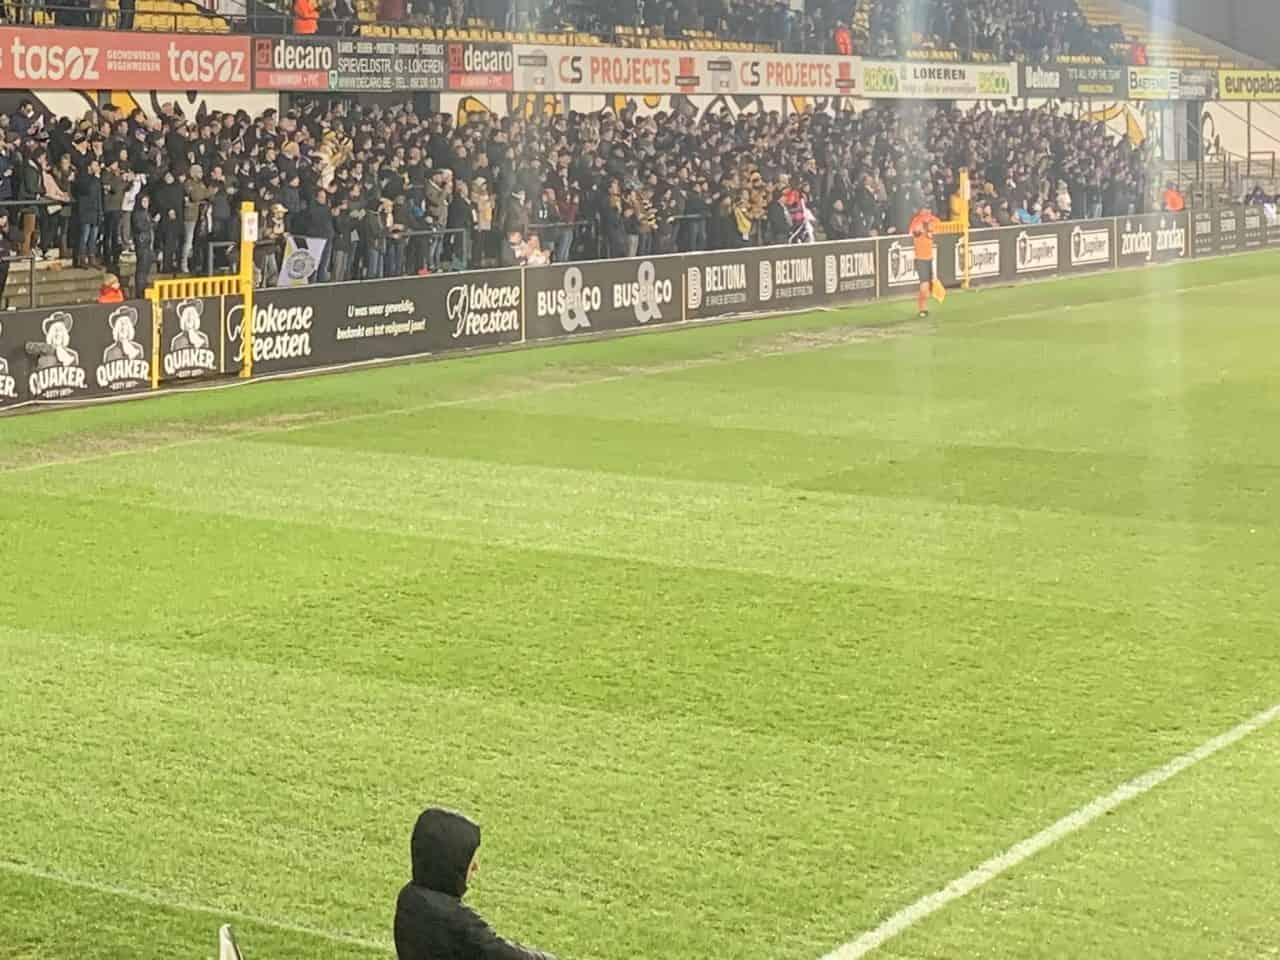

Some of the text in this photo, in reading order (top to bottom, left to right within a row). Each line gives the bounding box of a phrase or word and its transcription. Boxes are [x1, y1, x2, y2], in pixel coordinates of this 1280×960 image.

[274, 39, 332, 69] decaro
[464, 43, 513, 72] decaro
[559, 56, 583, 84] CS
[740, 60, 761, 85] CS
[913, 67, 966, 80] LOKEREN
[705, 263, 747, 292] BELTONA
[775, 257, 814, 284] BELTONA
[251, 331, 312, 361] eesten
[96, 359, 149, 389] QUAKER
[164, 348, 213, 378] QUAKER
[29, 366, 85, 396] QUAKER
